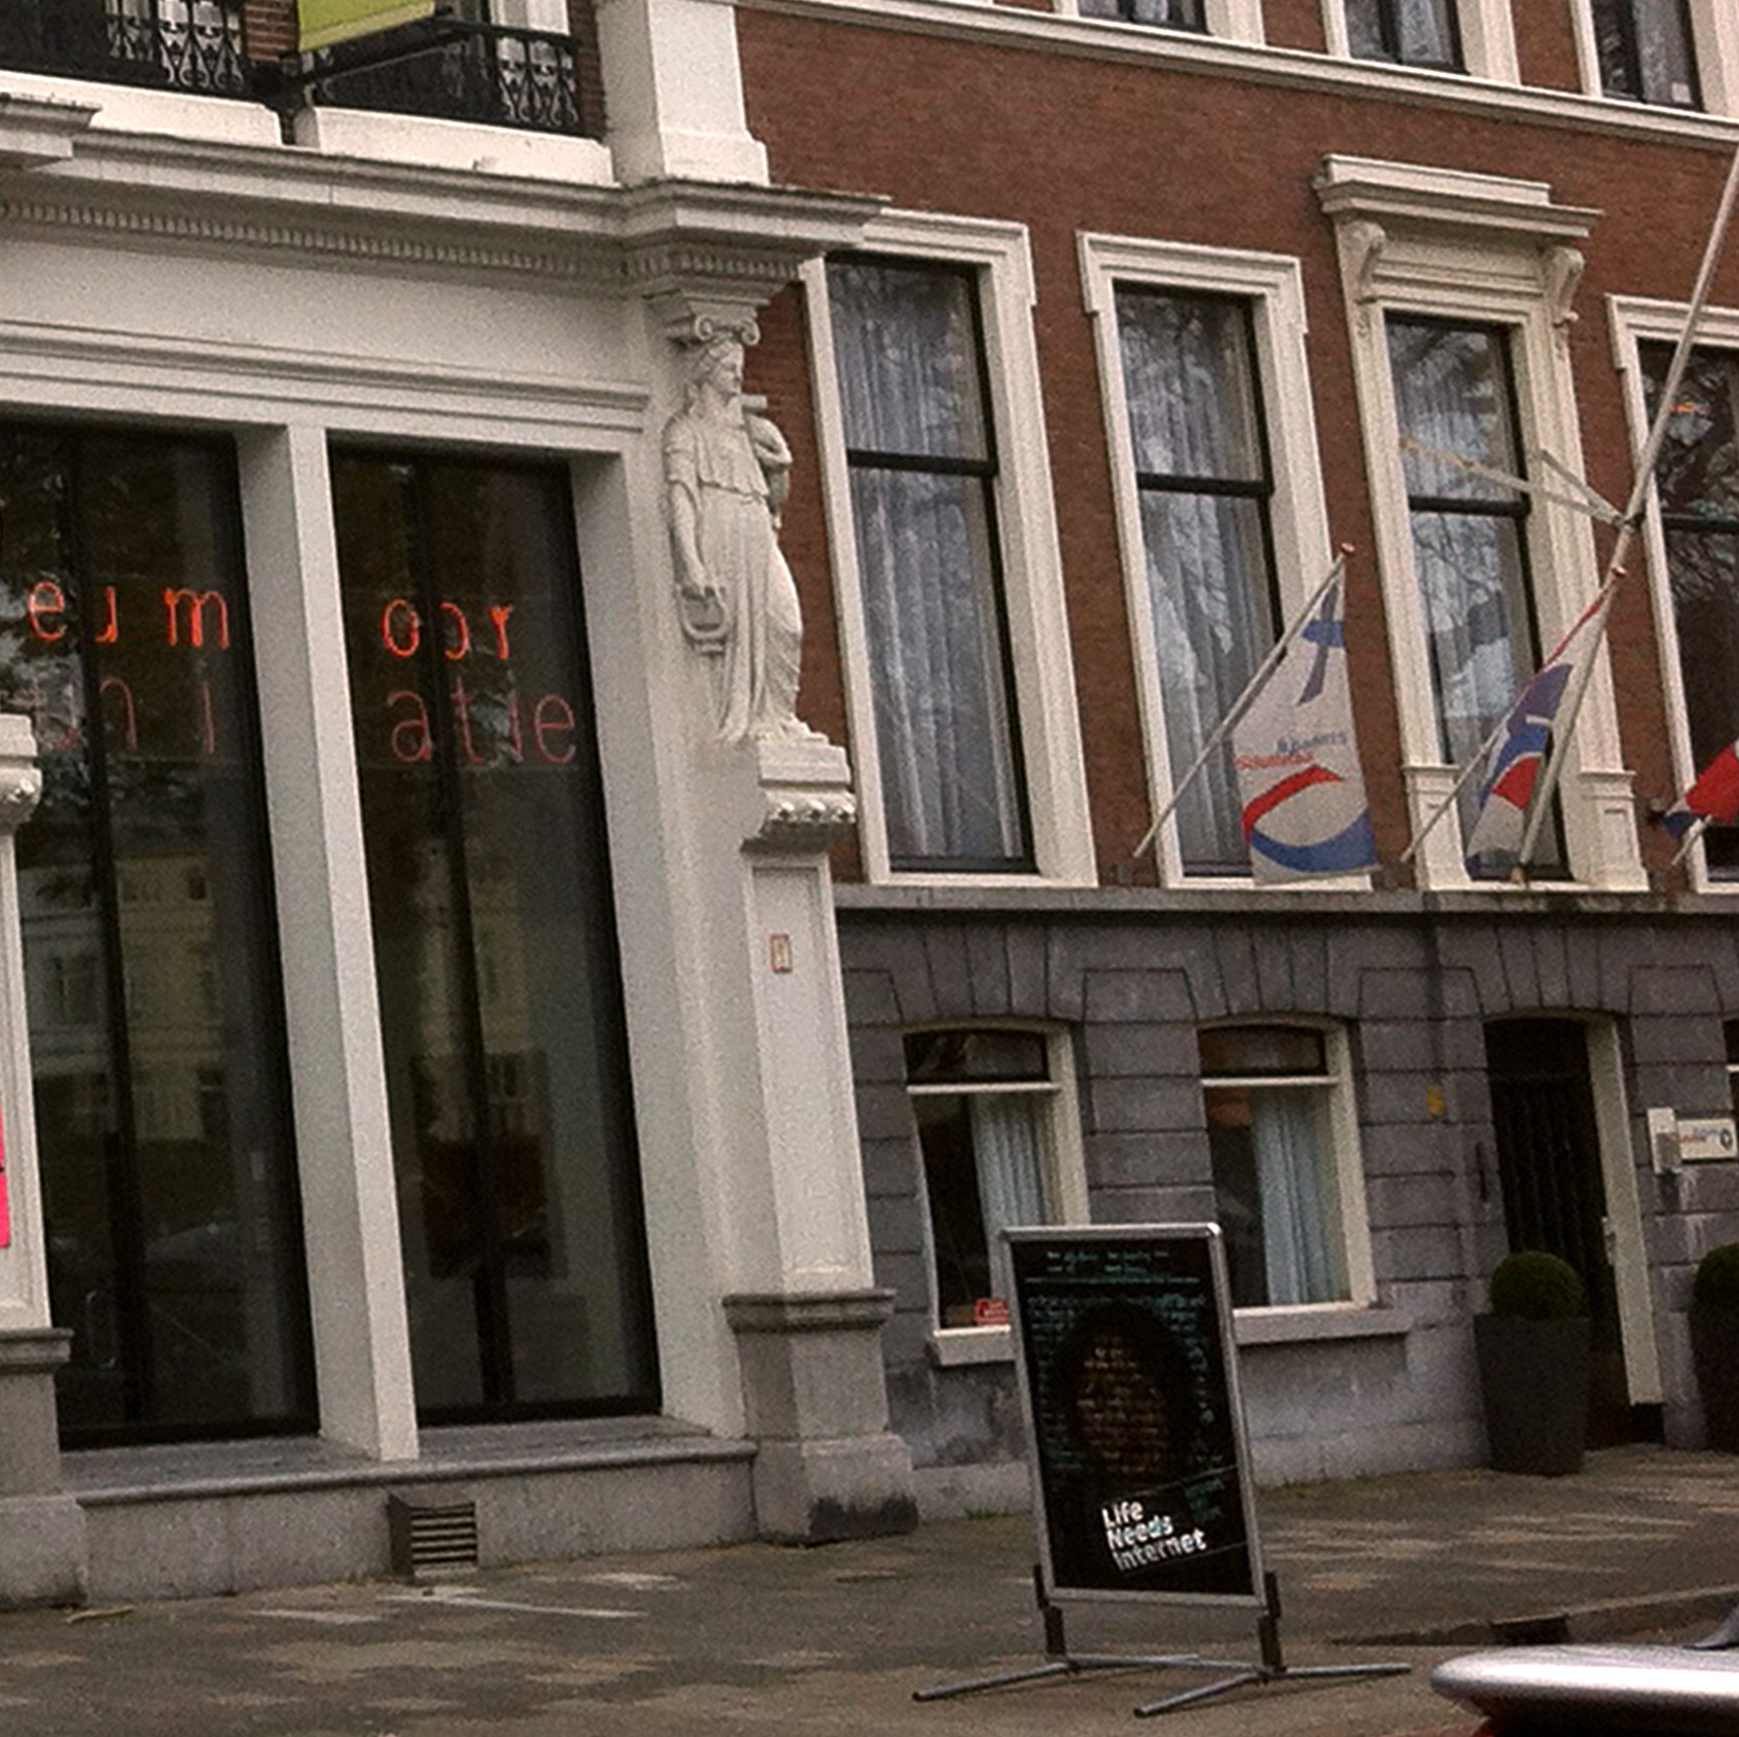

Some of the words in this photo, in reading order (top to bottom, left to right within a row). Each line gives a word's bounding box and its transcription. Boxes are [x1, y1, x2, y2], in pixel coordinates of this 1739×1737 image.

[1101, 1500, 1144, 1529] Life
[1106, 1514, 1174, 1551] Needs
[1111, 1526, 1208, 1573] Internet
